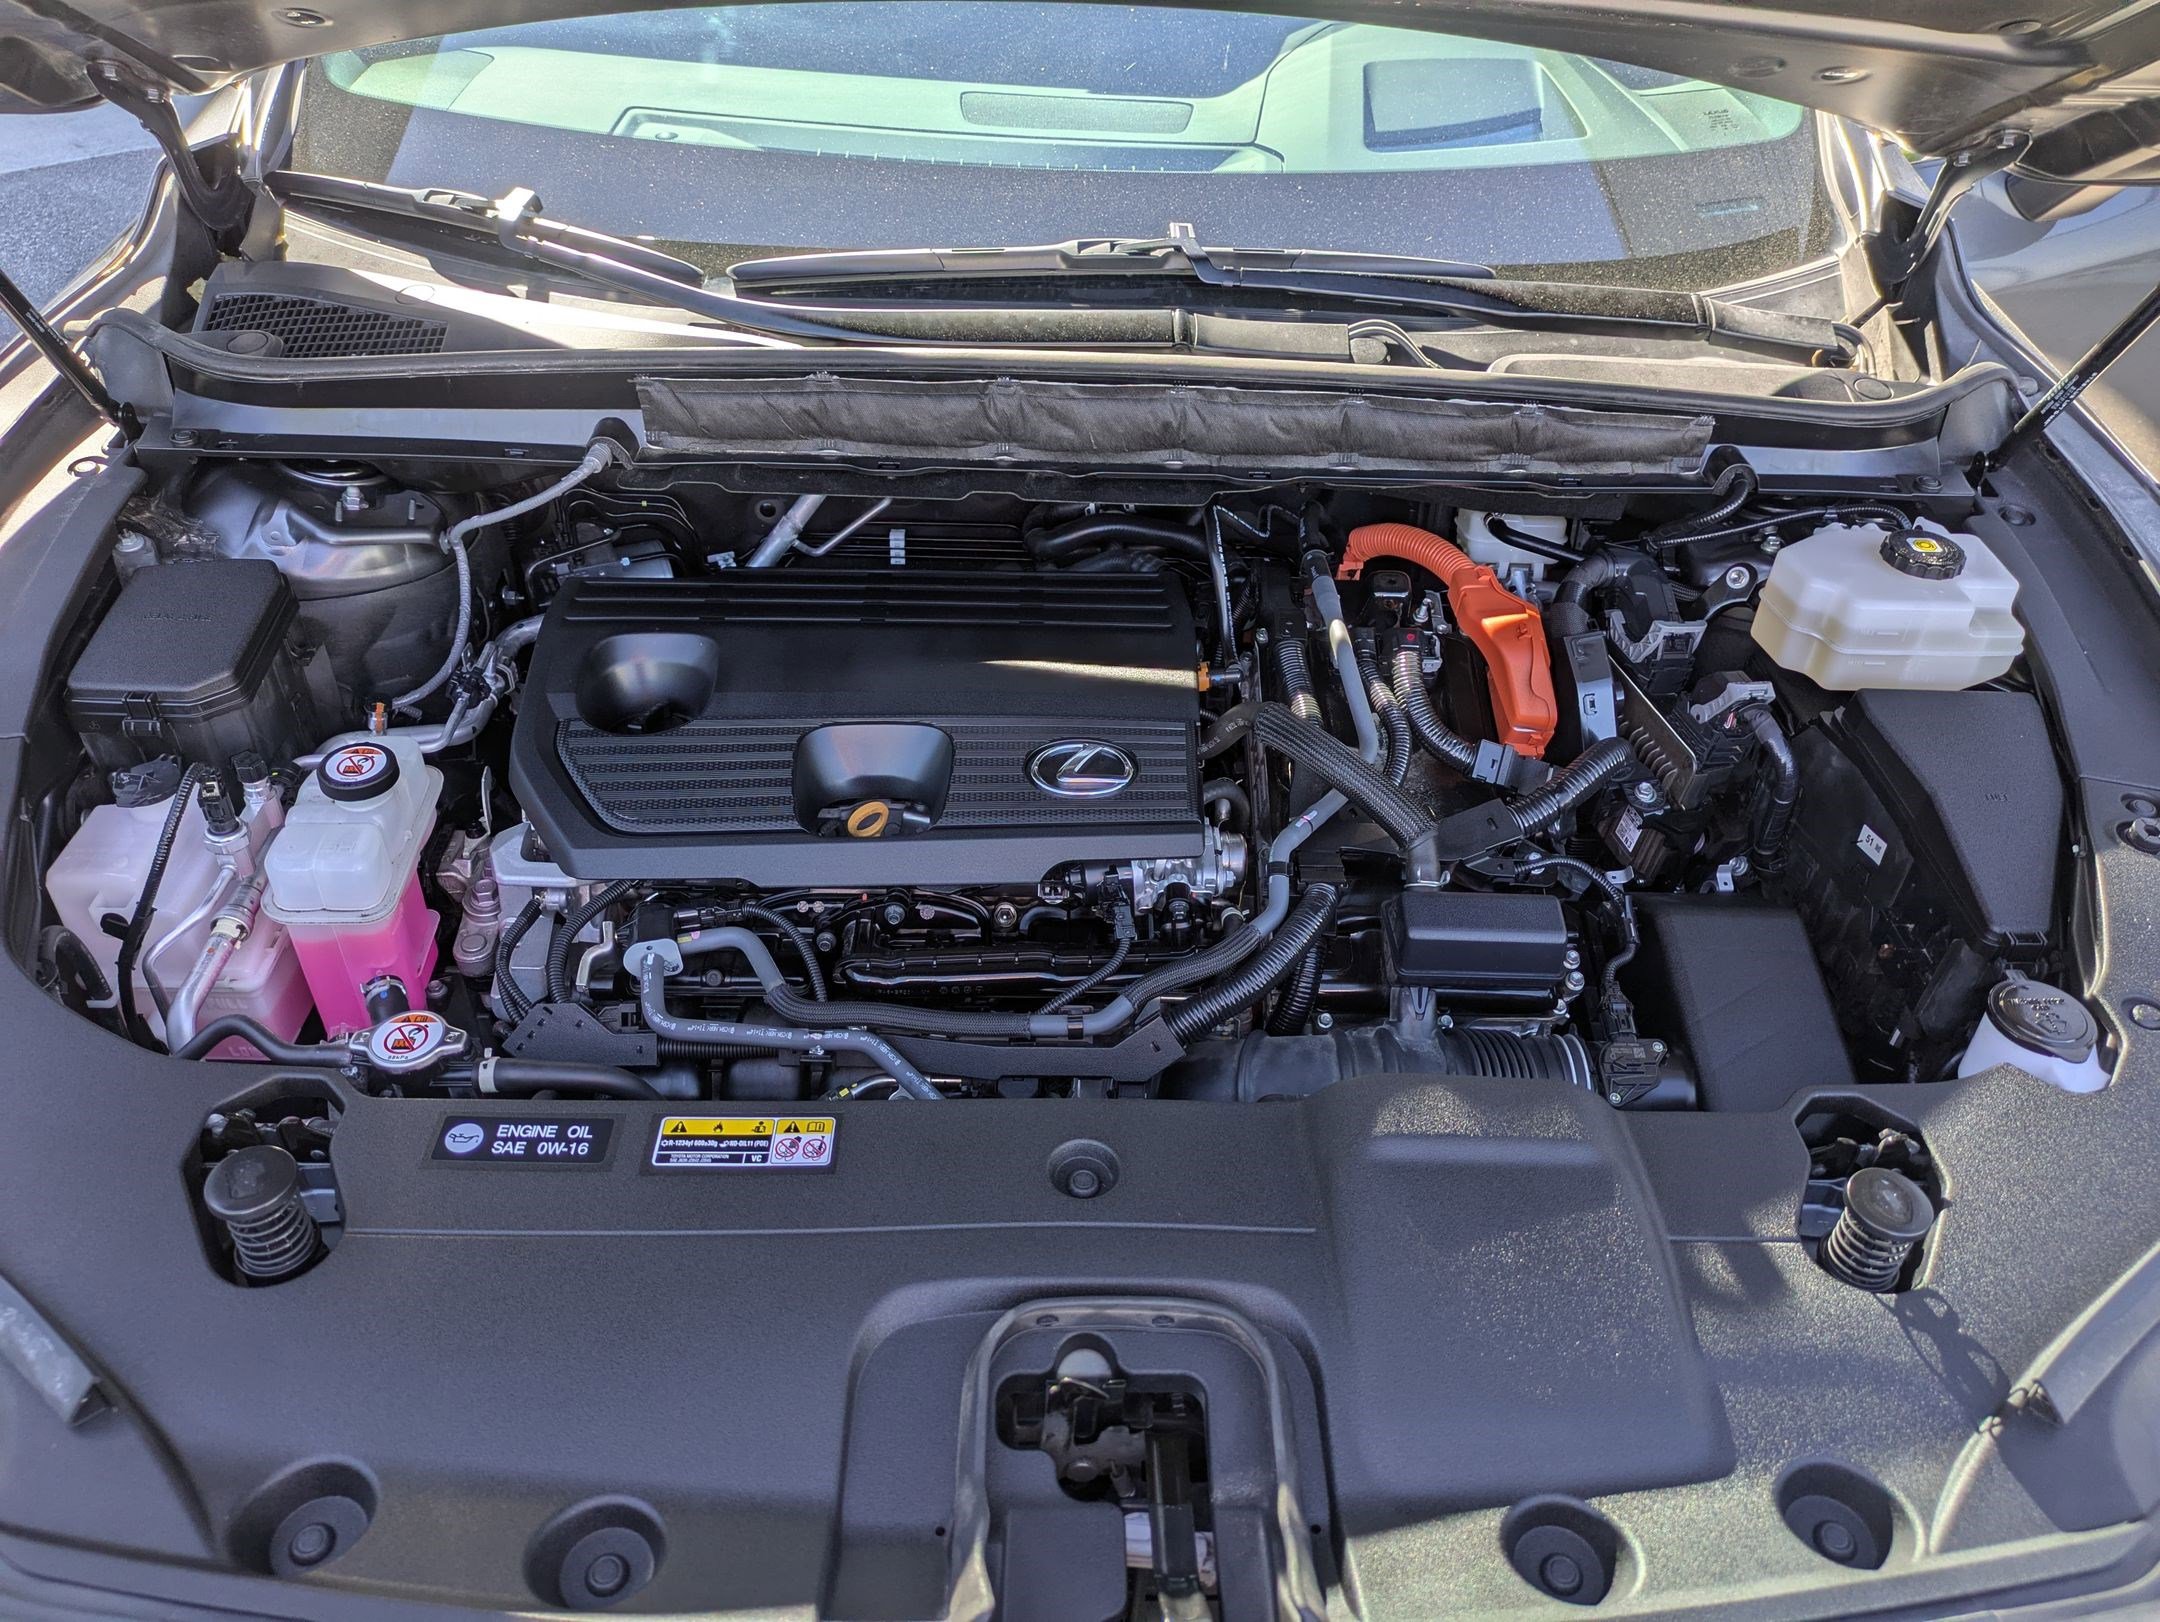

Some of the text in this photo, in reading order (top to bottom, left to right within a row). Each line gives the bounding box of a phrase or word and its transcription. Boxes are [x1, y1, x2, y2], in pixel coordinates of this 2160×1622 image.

[496, 1124, 593, 1139] ENGINE OIL
[491, 1141, 589, 1155] SAE 0W-16
